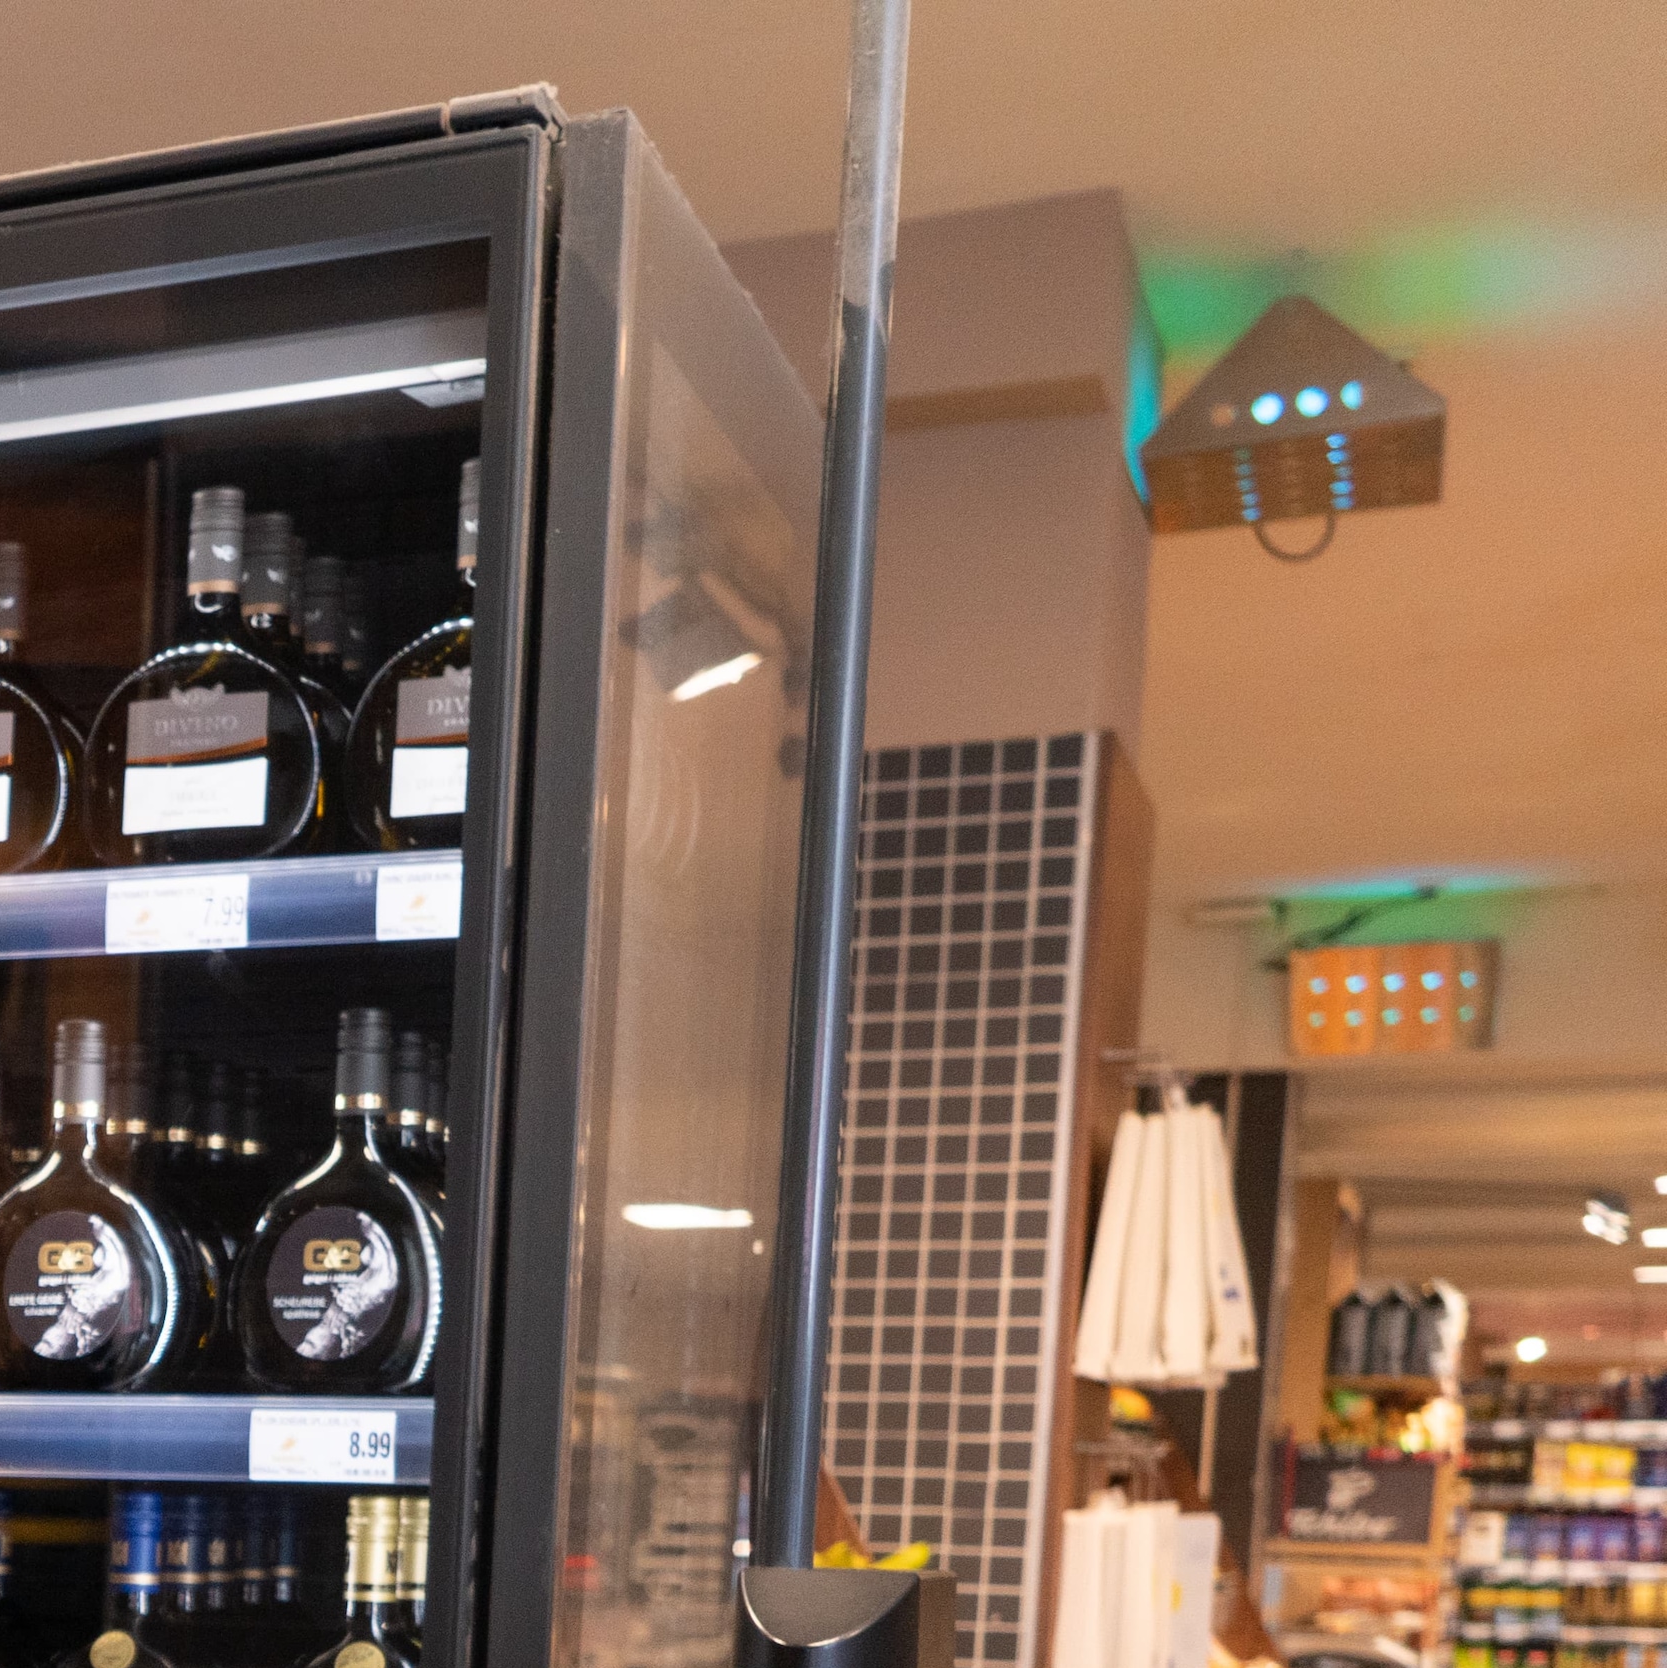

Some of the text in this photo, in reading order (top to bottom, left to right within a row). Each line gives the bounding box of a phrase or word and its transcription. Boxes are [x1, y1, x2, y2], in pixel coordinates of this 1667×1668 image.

[427, 696, 470, 715] DIV
[154, 716, 237, 736] DIVINO
[204, 895, 245, 927] 7.99
[349, 1431, 390, 1459] 8.99
